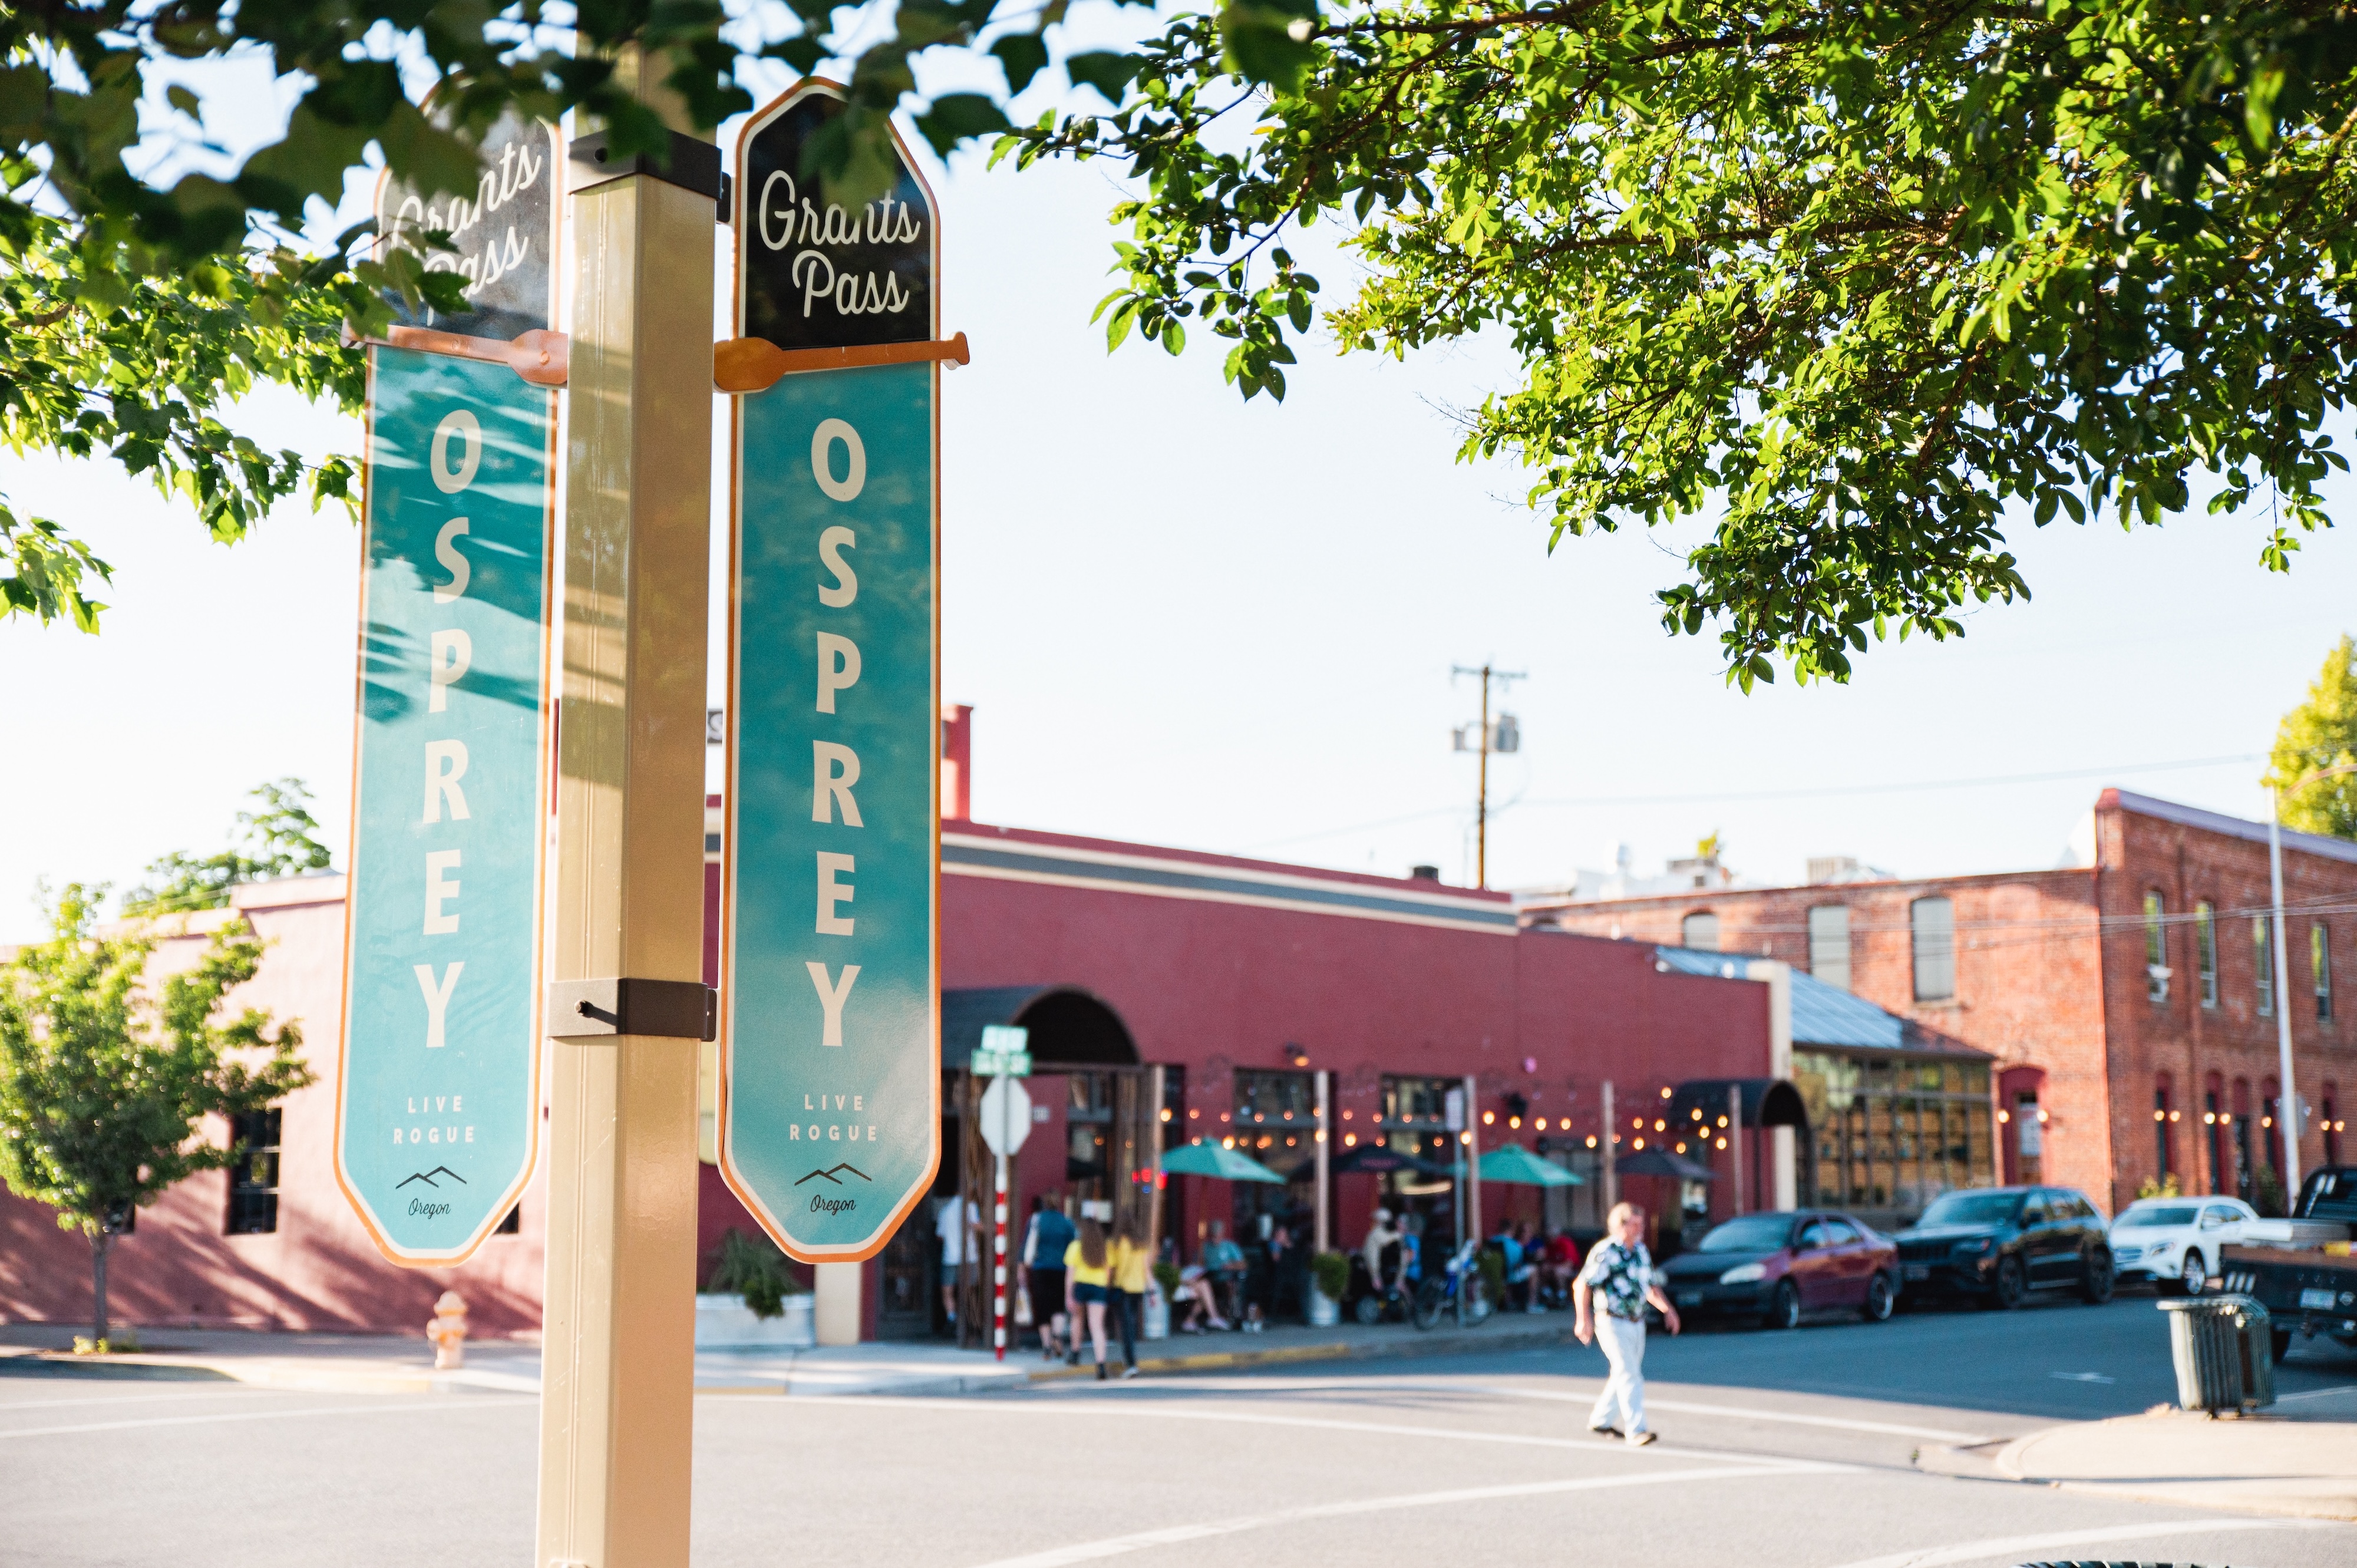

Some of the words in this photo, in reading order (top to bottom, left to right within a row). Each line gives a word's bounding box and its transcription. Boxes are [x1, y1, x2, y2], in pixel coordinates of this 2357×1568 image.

[759, 169, 920, 250] Grants
[792, 249, 909, 318] Pass
[413, 409, 482, 1049] OSPREY
[805, 418, 867, 1047] OSPREY
[408, 1095, 462, 1113] LIVE
[804, 1094, 863, 1111] LIVE
[394, 1126, 474, 1144] ROGUE
[790, 1124, 876, 1141] ROGUE
[408, 1198, 451, 1219] Oregon
[810, 1194, 856, 1216] Oregon
